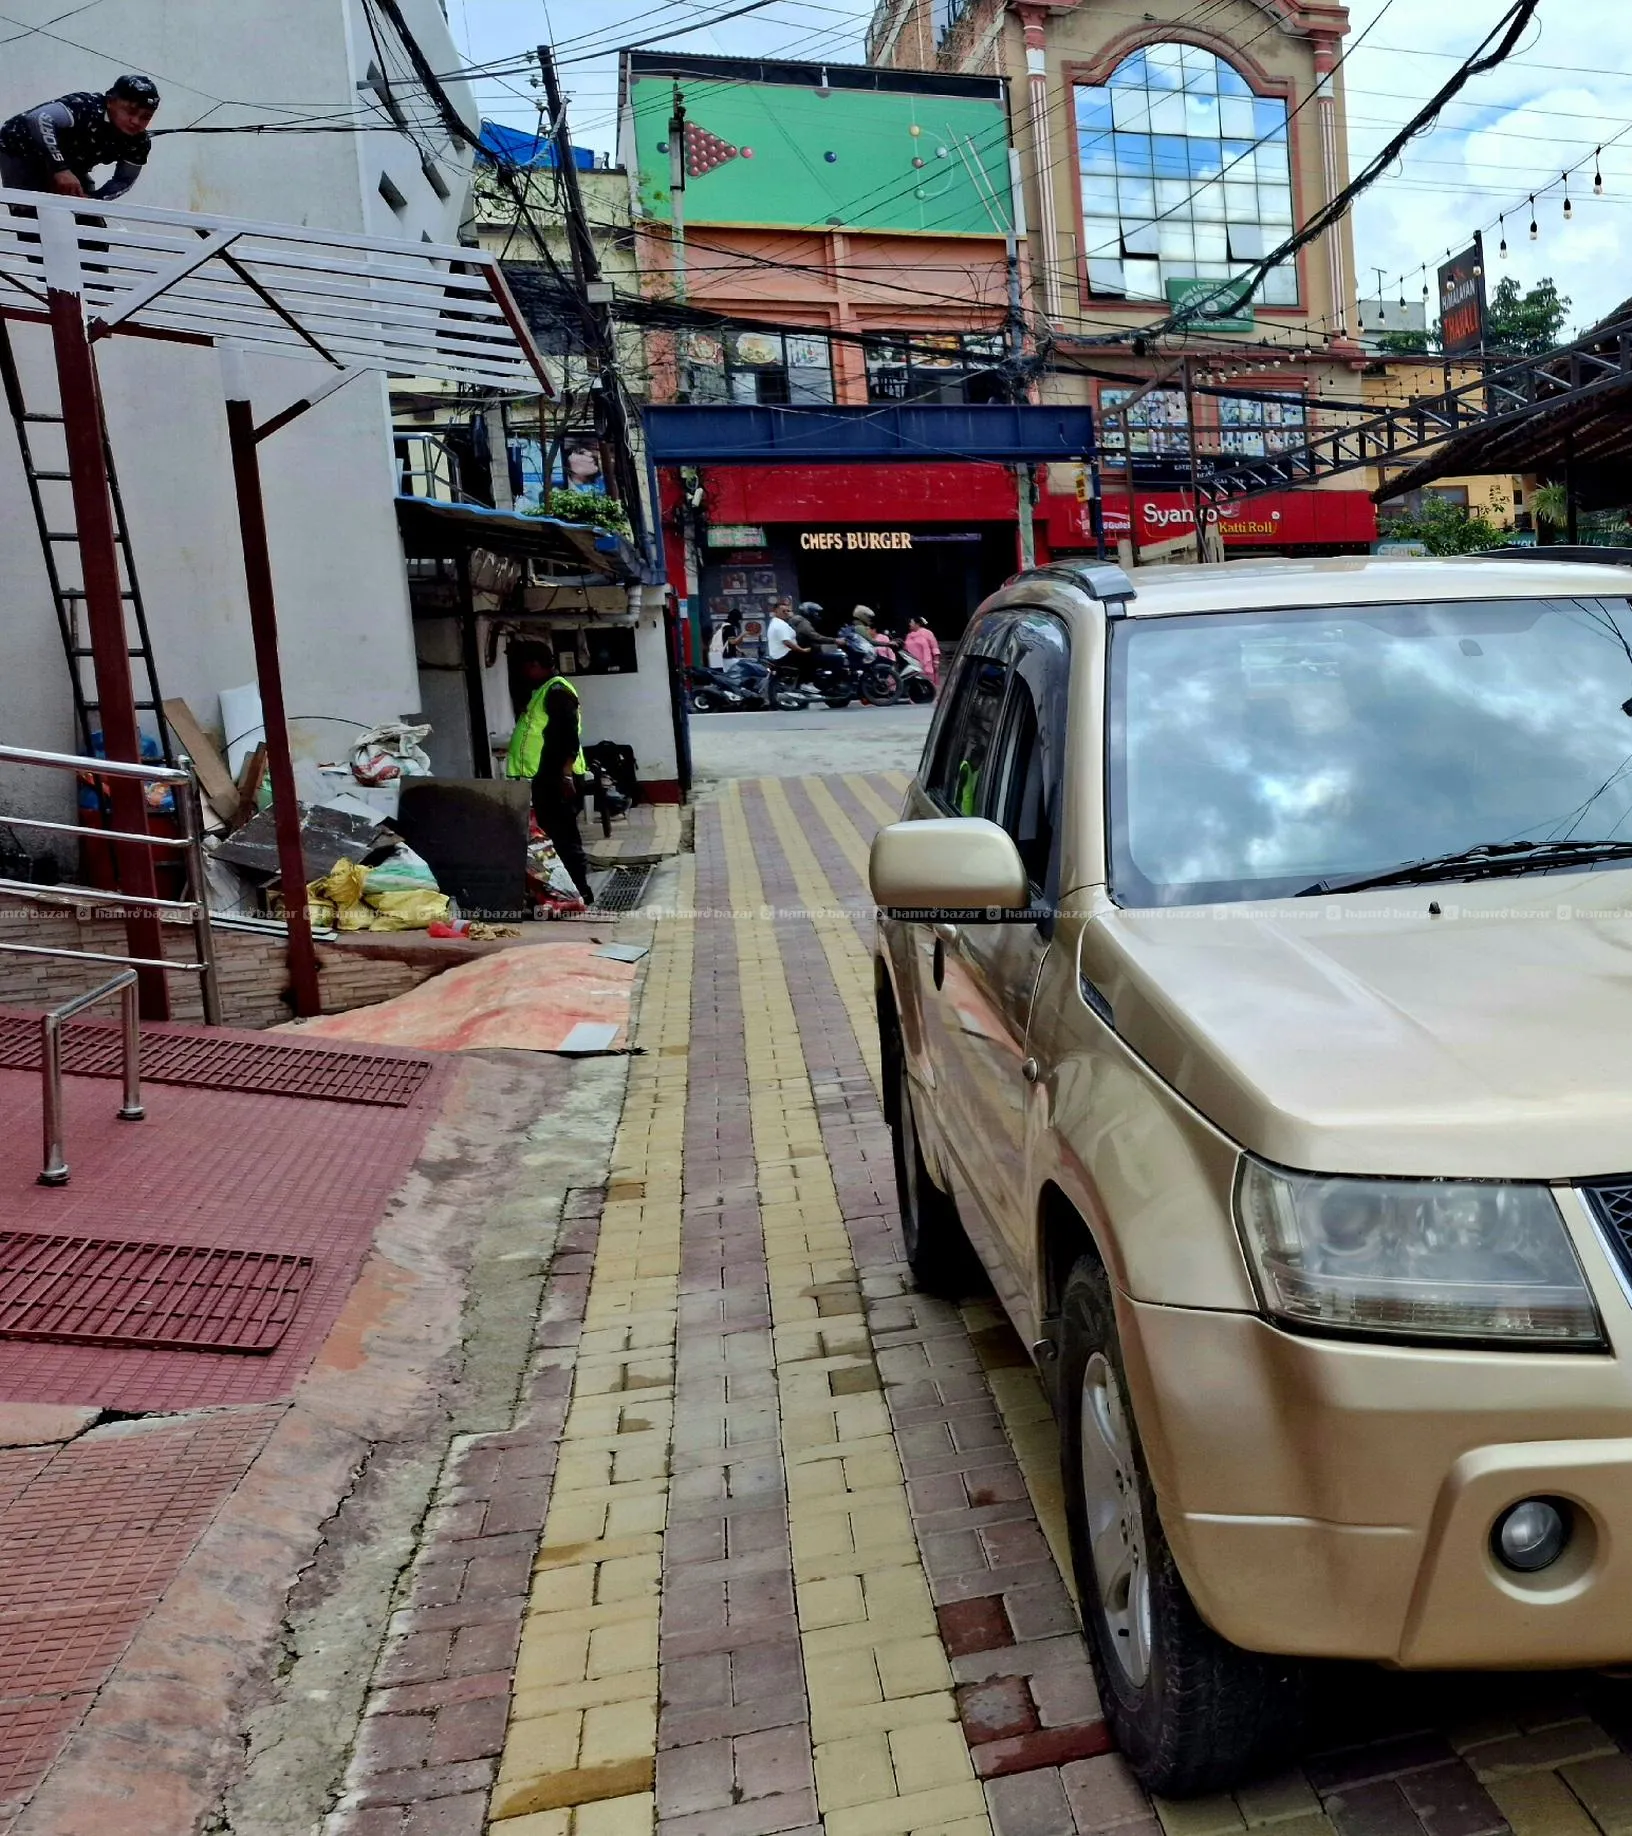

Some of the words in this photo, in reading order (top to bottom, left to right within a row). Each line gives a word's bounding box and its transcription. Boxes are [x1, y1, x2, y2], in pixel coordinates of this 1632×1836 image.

[1219, 520, 1247, 533] Katti
[1249, 520, 1273, 533] Roll
[801, 533, 843, 550] CHEFS
[847, 532, 912, 550] BURGER
